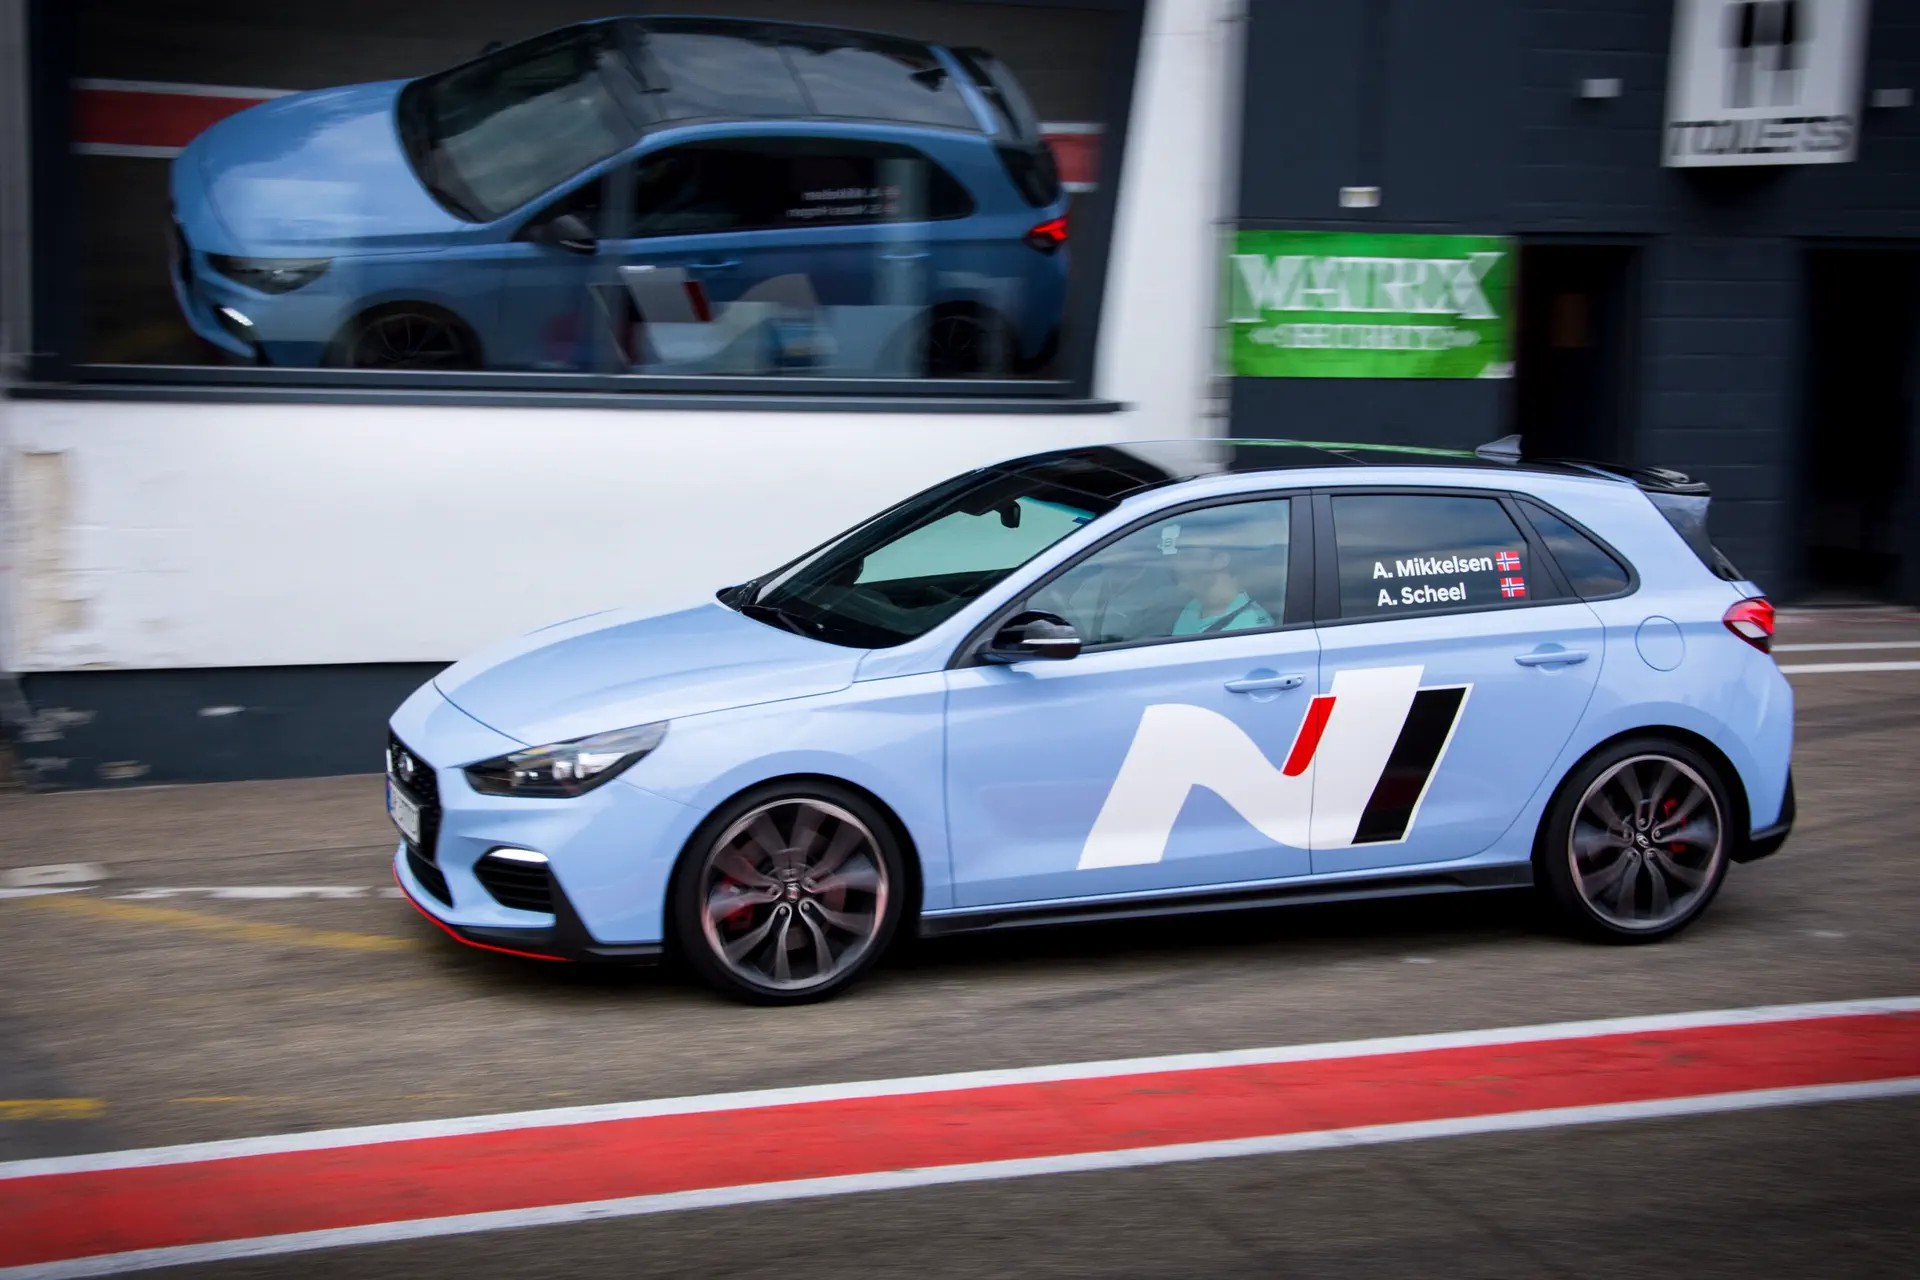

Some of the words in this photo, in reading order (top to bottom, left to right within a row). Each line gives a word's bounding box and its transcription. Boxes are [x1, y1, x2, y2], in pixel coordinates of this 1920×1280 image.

[1373, 562, 1393, 579] A.
[1396, 556, 1493, 577] Mikkelsen
[1378, 589, 1397, 606] A.
[1401, 582, 1466, 604] Scheel
